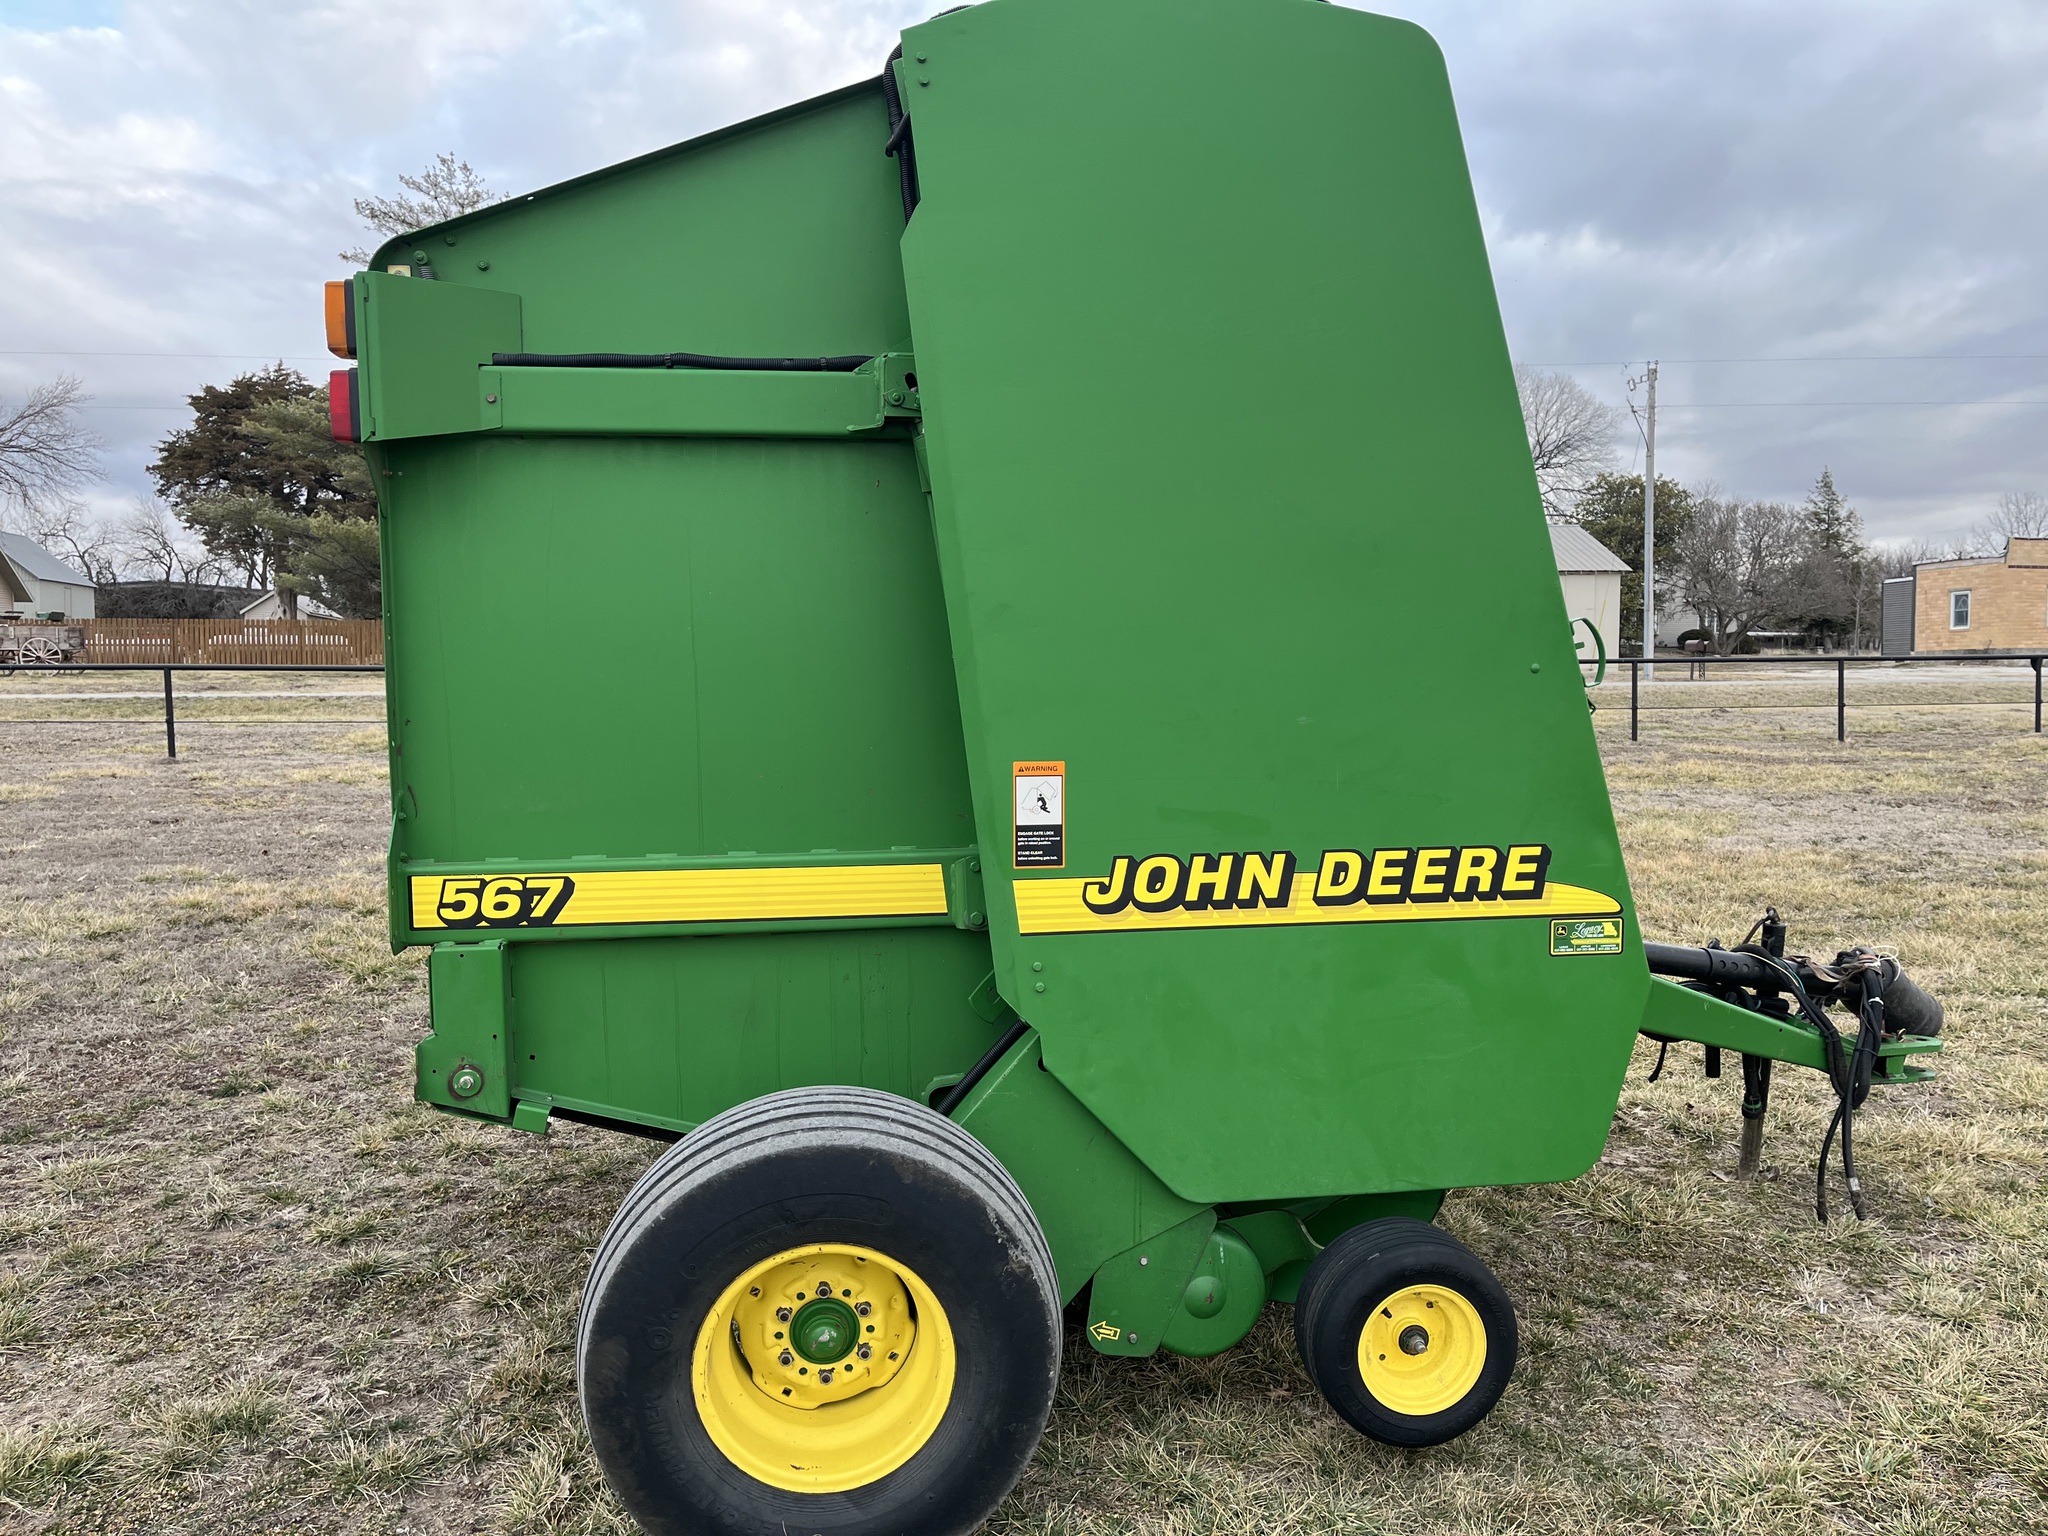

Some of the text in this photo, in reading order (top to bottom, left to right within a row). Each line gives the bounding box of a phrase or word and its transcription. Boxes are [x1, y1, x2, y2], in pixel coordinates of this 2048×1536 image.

[438, 877, 570, 922] 567
[1084, 845, 1549, 911] JOHN DEERE
[1572, 922, 1604, 938] Legacy
